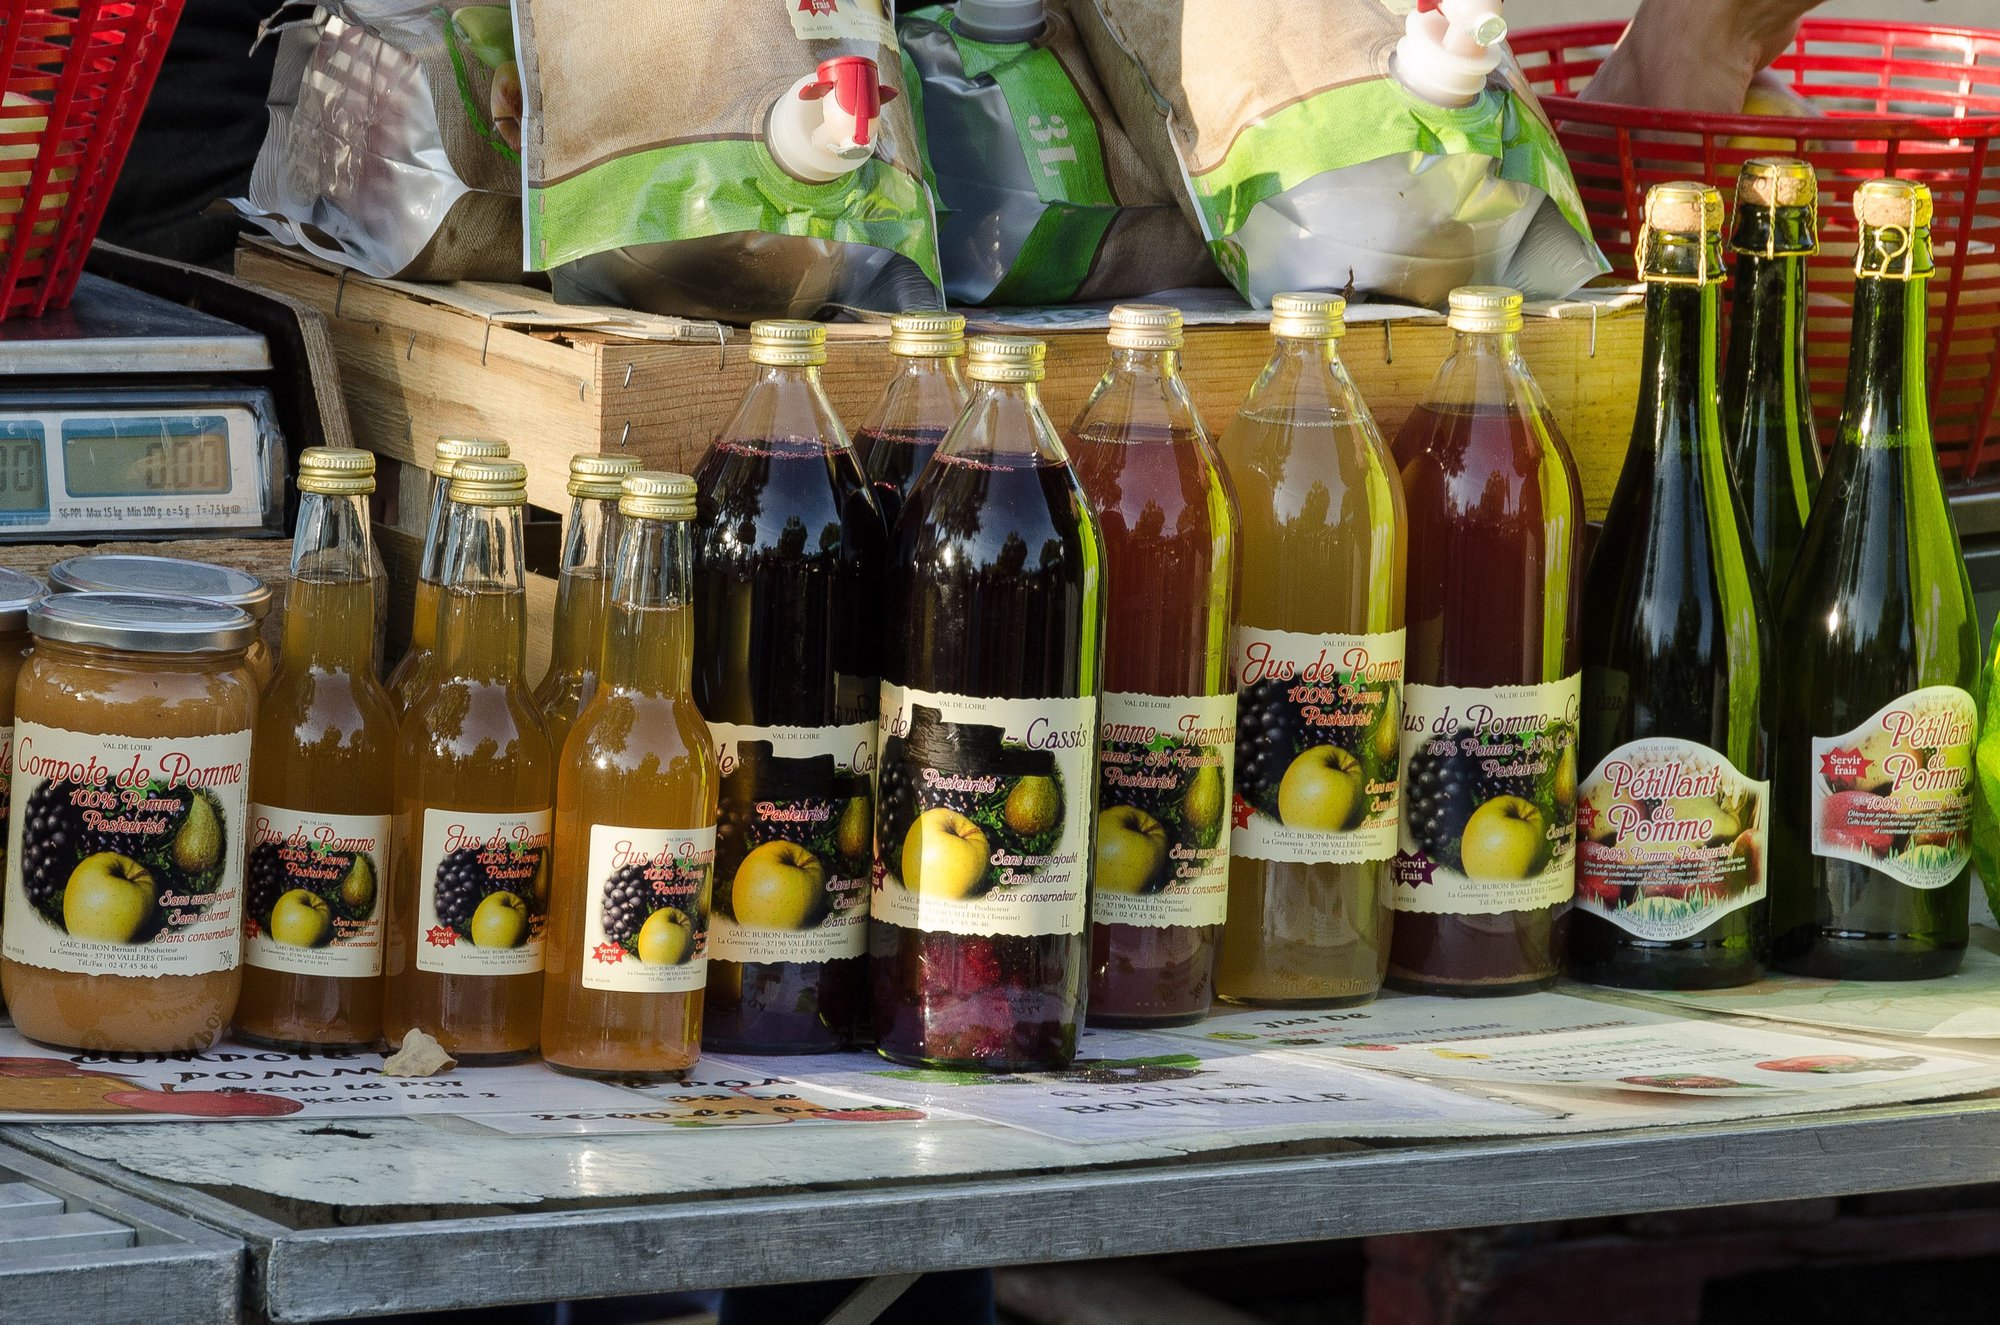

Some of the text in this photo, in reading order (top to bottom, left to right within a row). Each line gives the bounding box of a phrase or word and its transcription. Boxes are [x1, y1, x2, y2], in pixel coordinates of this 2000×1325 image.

[1028, 115, 1078, 177] 3L
[86, 507, 102, 518] Max
[104, 507, 112, 517] 15
[114, 506, 122, 520] kg
[127, 506, 141, 517] Min
[143, 506, 156, 517] 100
[157, 508, 162, 519] g
[185, 507, 190, 519] g
[1241, 642, 1294, 685] Jus
[1302, 648, 1334, 683] de
[1288, 685, 1333, 704] 100%
[891, 707, 907, 737] de
[1432, 706, 1459, 735] de
[1466, 704, 1548, 737] Pomme
[1882, 710, 1973, 749] Pétillant
[1026, 717, 1088, 750] Cassis
[1103, 722, 1156, 744] omme
[103, 742, 116, 750] VAL
[1461, 738, 1513, 757] Pomme
[18, 736, 242, 790] Compote de Pomme
[1482, 759, 1549, 778] Pasteurisé
[1830, 754, 1862, 765] Servir
[1928, 748, 1945, 770] de
[1104, 766, 1177, 790] Pasteurisé
[1604, 760, 1720, 799] Pétillant
[1834, 765, 1857, 775] frais
[1884, 754, 1968, 792] Pomme
[922, 768, 996, 793] Pasteurisé
[69, 788, 181, 812] 100% Pomme
[1867, 796, 1902, 811] 100%
[756, 801, 829, 822] Pasteurisé
[1652, 801, 1674, 821] de
[82, 809, 166, 834] Pasteurisé
[1608, 804, 1713, 843] Pomme
[254, 817, 376, 852] Jus de Pomme
[444, 824, 481, 854] Jus
[486, 827, 507, 851] de
[1273, 831, 1324, 840] GAEC BURON
[612, 840, 674, 869] Jus de
[991, 848, 1079, 869] Sans sucre ajouté
[1169, 843, 1195, 859] Sans
[1596, 842, 1733, 861] 100% Pomme Pasteurisé
[1176, 862, 1201, 878] Sans
[1397, 858, 1427, 869] Servir
[826, 875, 850, 892] Sans
[1000, 868, 1070, 885] Sans colorant
[1400, 870, 1423, 881] frais
[986, 886, 1077, 903] Sans conservateur
[1164, 880, 1190, 895] Sans
[1459, 882, 1509, 891] GAEC BURON
[1495, 890, 1514, 898] 37190
[159, 890, 189, 907] Sans
[1123, 896, 1148, 904] Bernard
[168, 906, 231, 925] Sans colorant
[822, 913, 846, 928] Sans
[155, 928, 185, 944] Sans
[187, 925, 237, 942] conservateur
[727, 939, 759, 947] Greneterie
[787, 939, 823, 947] VALLÈRES
[729, 930, 781, 939] GAEC BURON
[50, 946, 58, 954] La
[117, 952, 154, 962] VALLÈRES
[156, 953, 187, 962] (Touraine)
[59, 940, 178, 954] GAEC BURON Bernard Producteur
[78, 959, 102, 967] Tél./Fax
[174, 1066, 388, 1083] POMM
